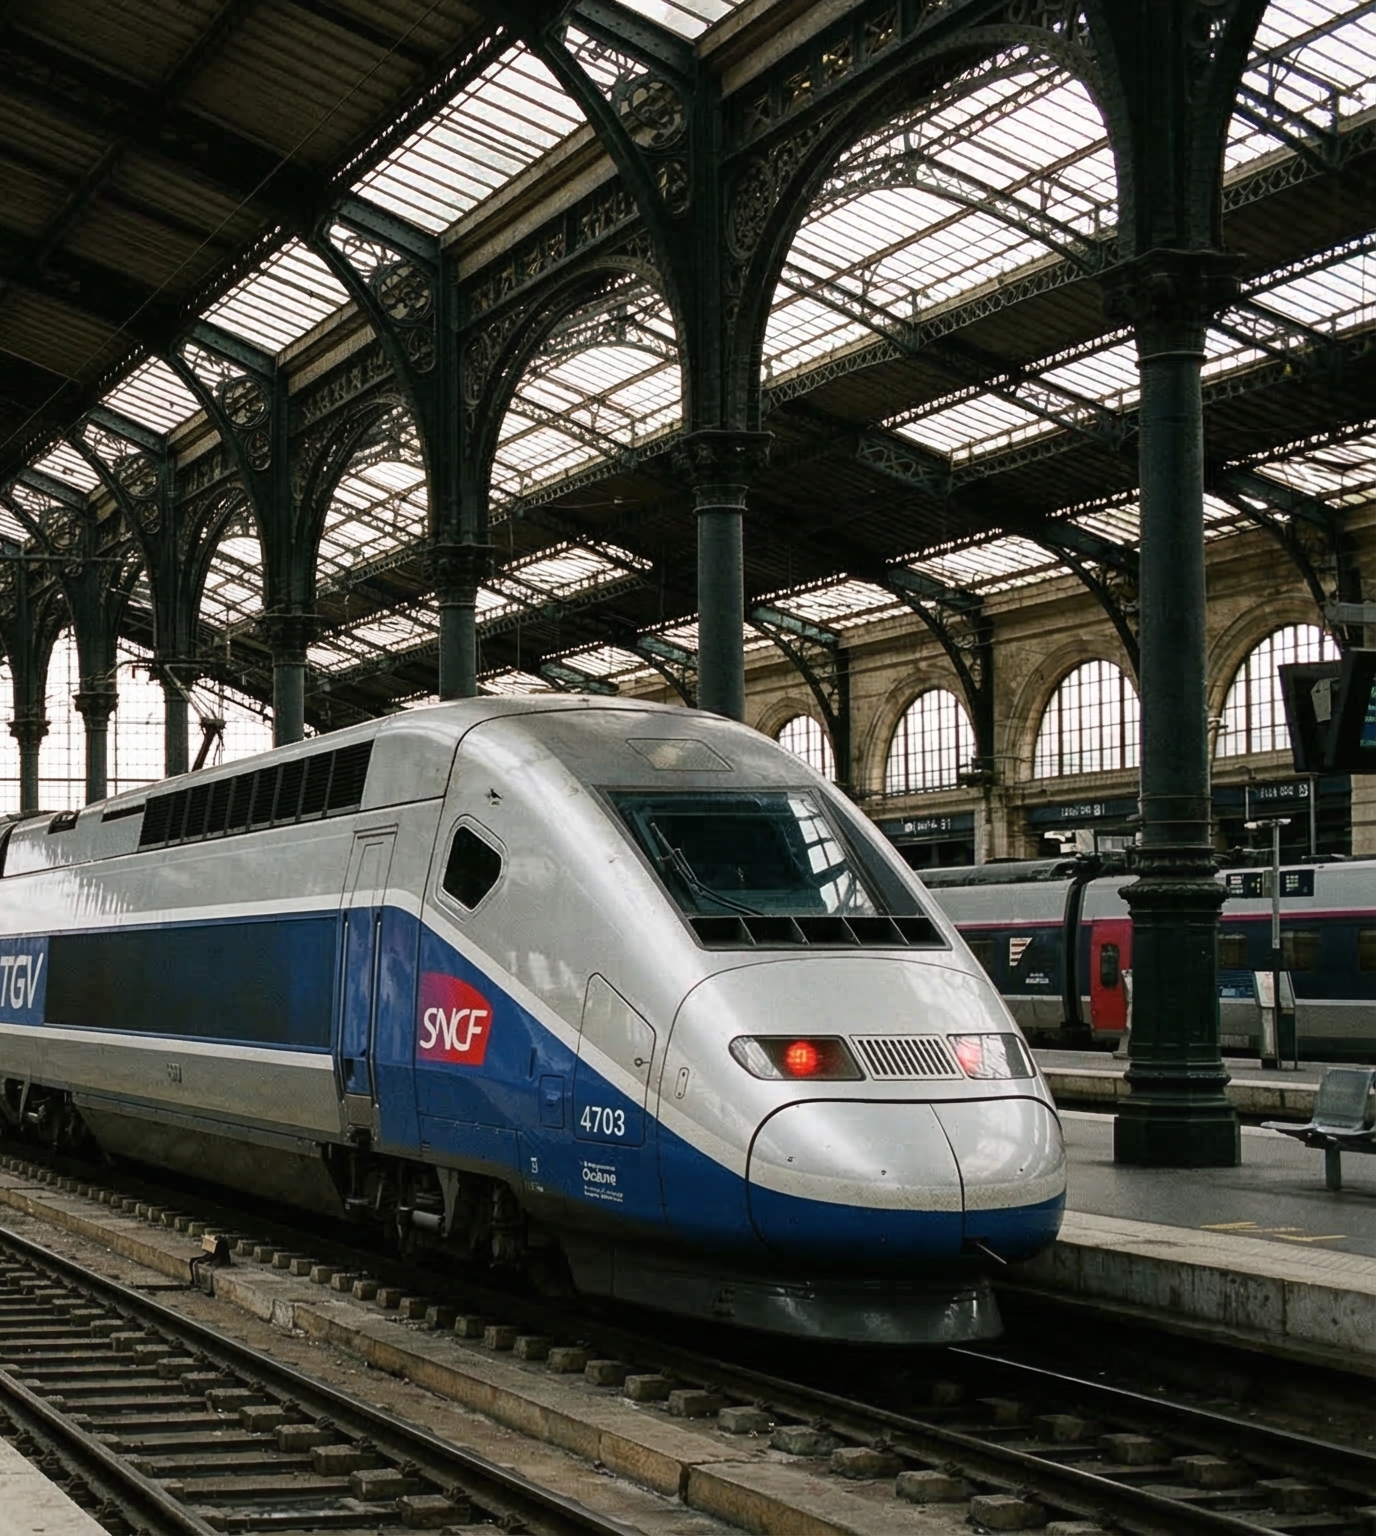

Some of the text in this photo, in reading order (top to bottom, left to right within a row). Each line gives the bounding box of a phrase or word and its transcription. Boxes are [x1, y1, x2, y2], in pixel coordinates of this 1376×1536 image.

[0, 952, 44, 1009] TGV
[418, 1006, 488, 1052] SNCF
[579, 1105, 625, 1136] 4703
